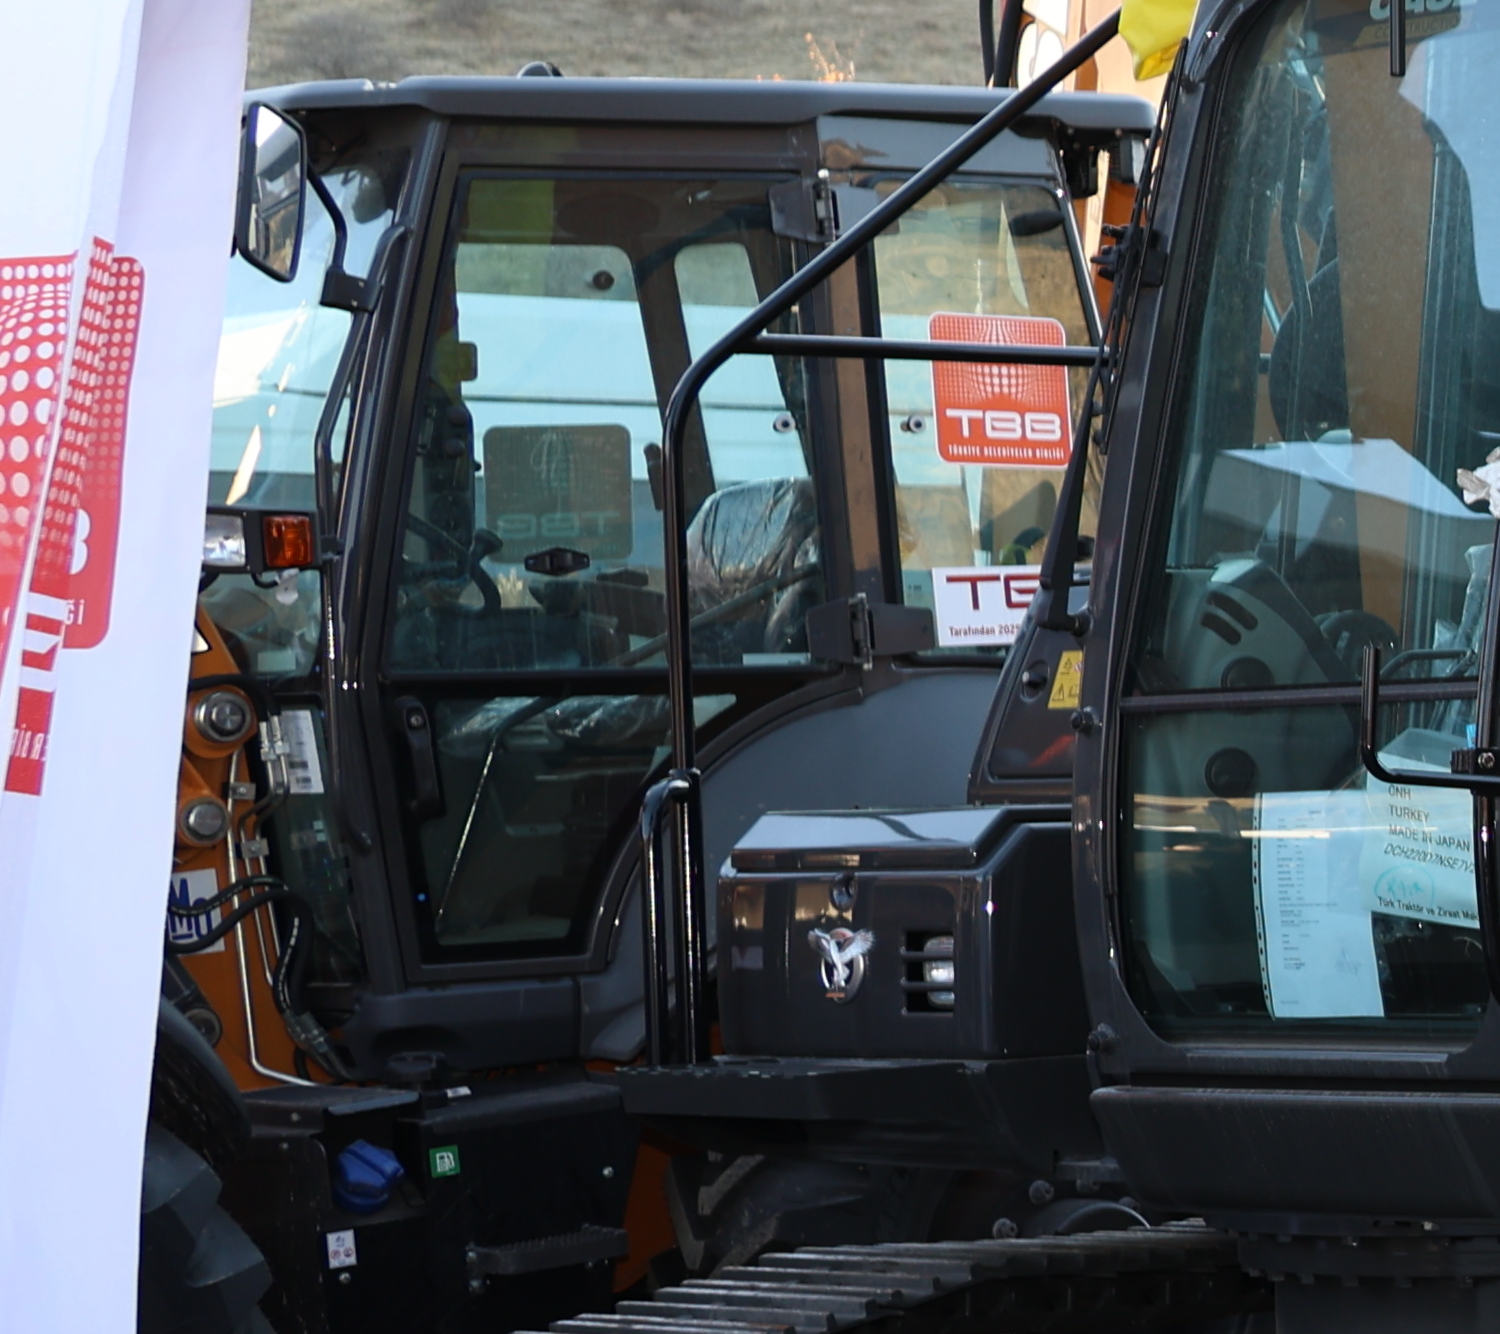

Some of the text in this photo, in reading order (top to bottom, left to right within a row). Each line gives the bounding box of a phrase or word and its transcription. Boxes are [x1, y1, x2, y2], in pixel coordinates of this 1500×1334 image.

[946, 408, 1062, 442] TBB
[1388, 804, 1430, 823] TURKEY
[1388, 823, 1471, 852] MADE IN JAPAN
